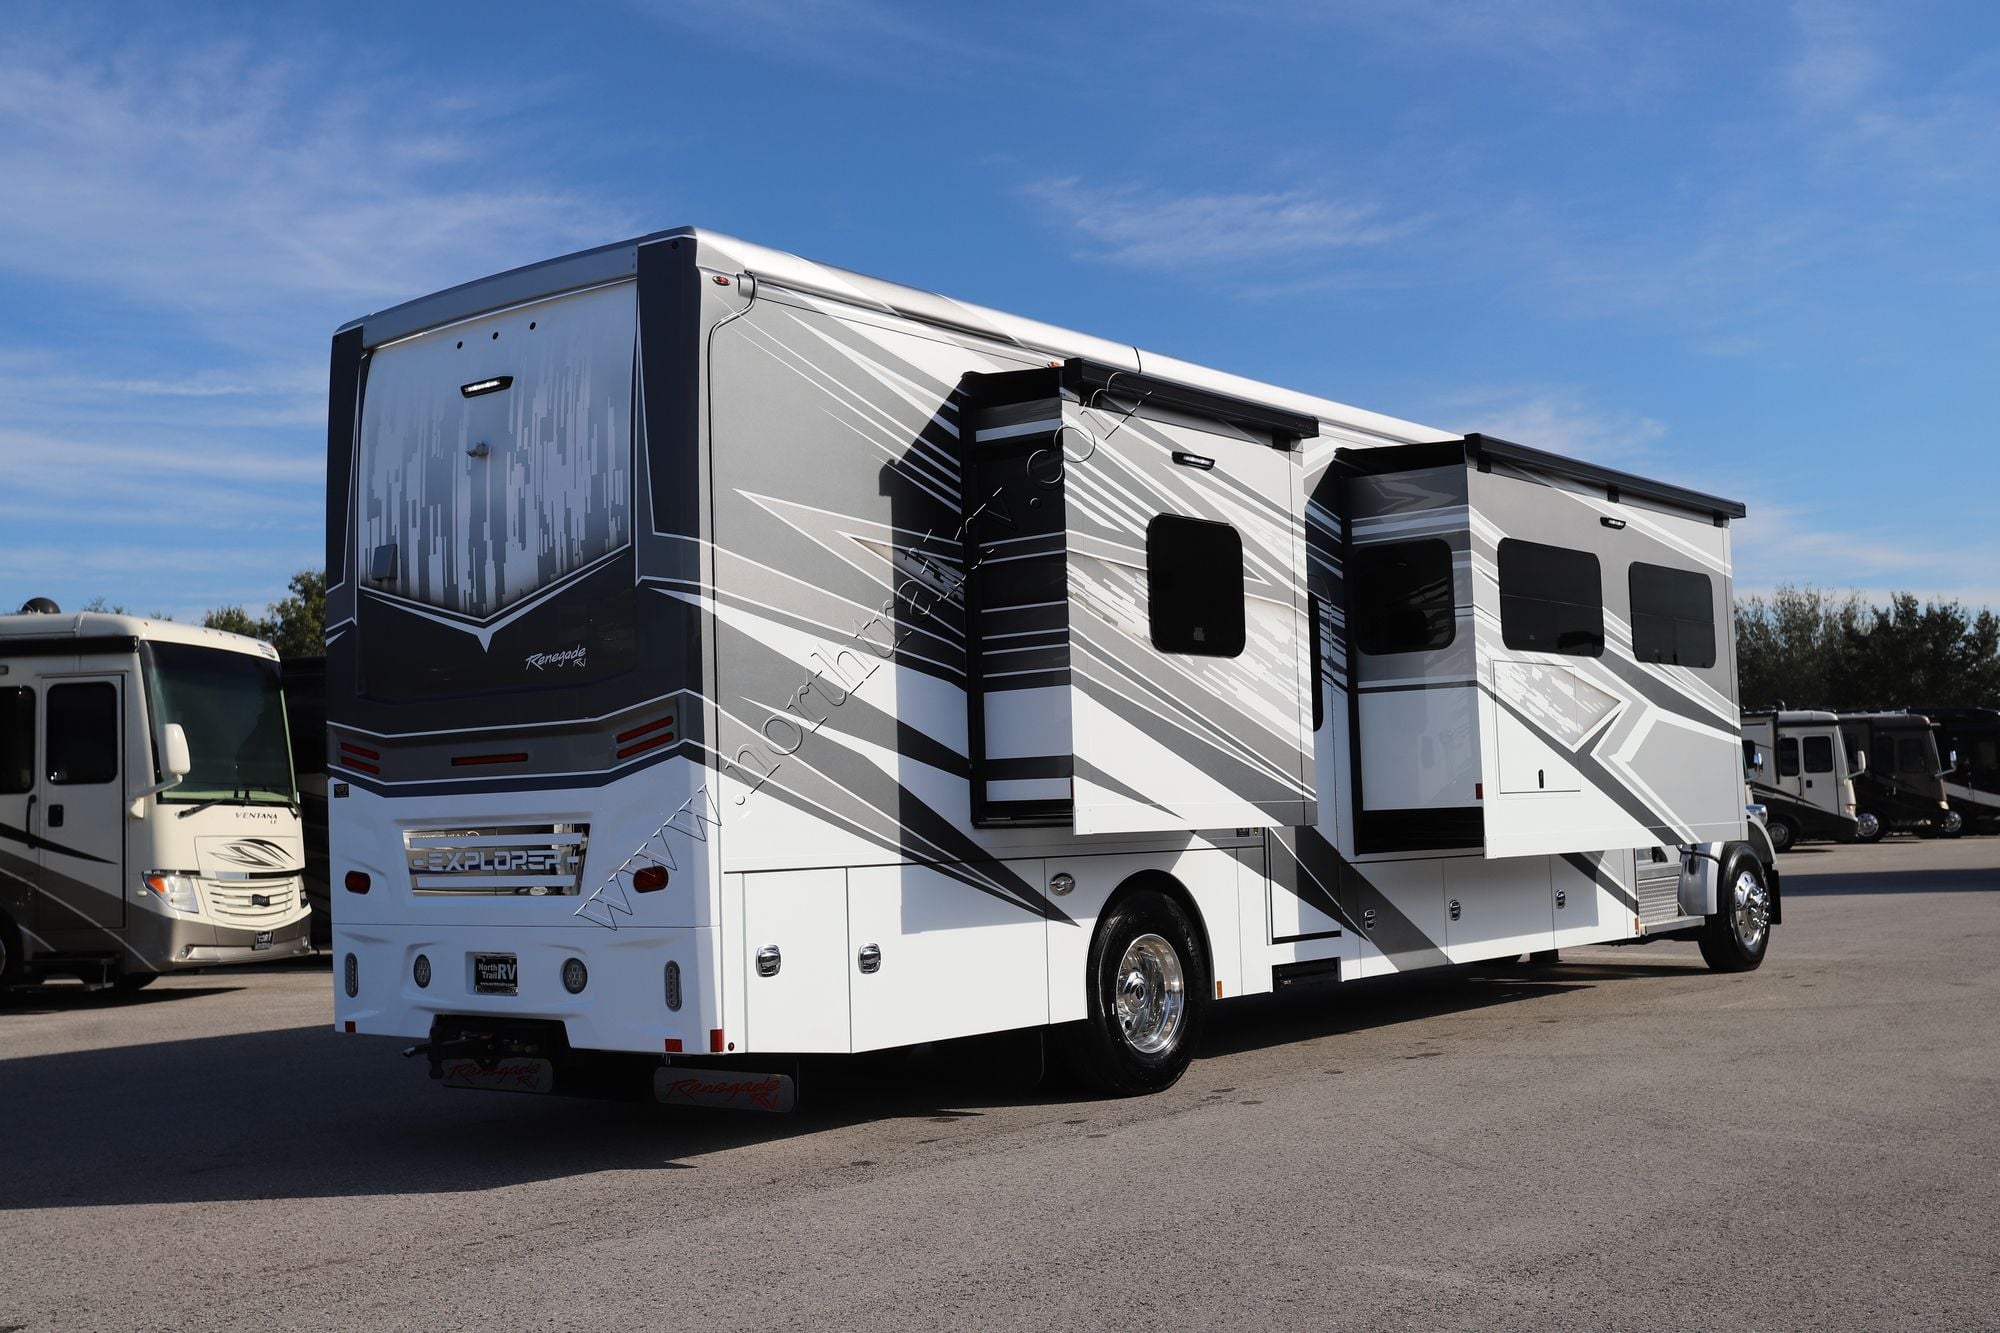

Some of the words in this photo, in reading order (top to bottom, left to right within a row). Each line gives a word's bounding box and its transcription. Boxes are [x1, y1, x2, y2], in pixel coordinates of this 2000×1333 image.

[525, 643, 586, 671] Renegade
[573, 657, 587, 667] RV
[235, 812, 278, 820] VENTANA
[478, 963, 498, 971] North
[497, 963, 517, 980] RV
[481, 971, 497, 979] Trail
[665, 1076, 781, 1103] Renegade
